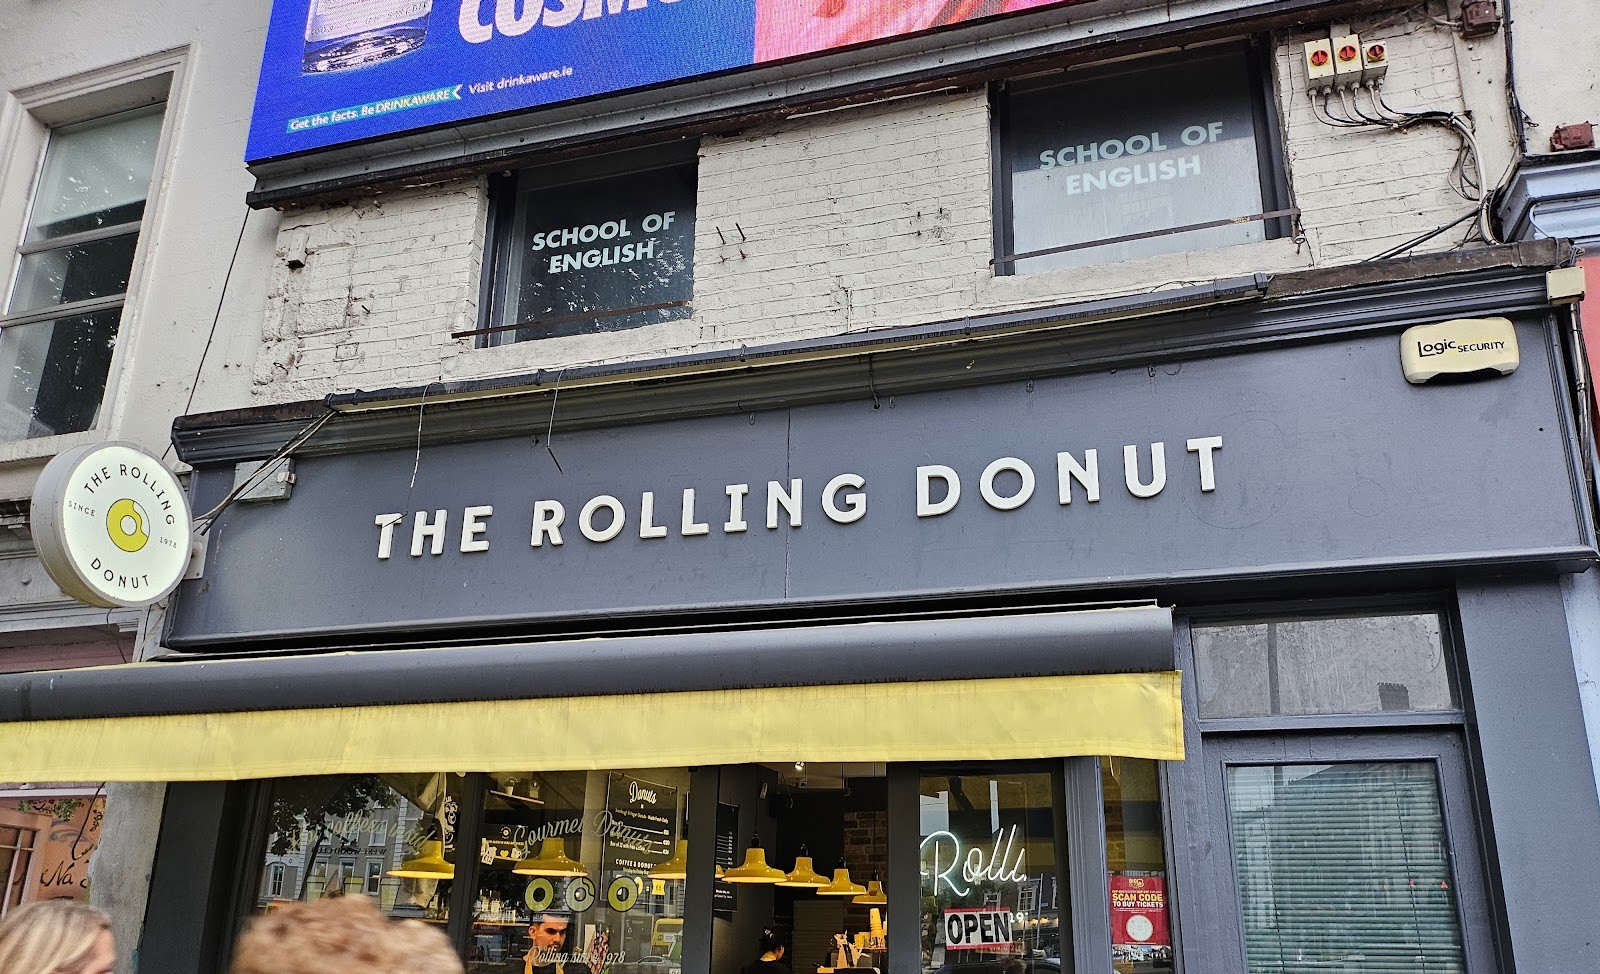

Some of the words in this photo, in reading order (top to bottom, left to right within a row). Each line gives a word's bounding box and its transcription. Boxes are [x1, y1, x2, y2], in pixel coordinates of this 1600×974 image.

[468, 82, 494, 95] Visit
[497, 66, 573, 89] drinkaware.ie
[290, 117, 309, 131] Get
[312, 113, 330, 126] the
[331, 109, 358, 123] facts.
[361, 104, 375, 116] Be
[375, 90, 450, 115] DRINKAWARE
[1039, 132, 1167, 170] SCHOOL
[1180, 121, 1223, 146] OF
[1066, 155, 1201, 196] ENGLISH
[532, 219, 631, 251] SCHOOL
[642, 211, 676, 233] OF
[549, 240, 654, 274] ENGLISH
[1417, 338, 1457, 358] Logic
[1457, 341, 1505, 353] SECURITY
[68, 500, 96, 517] SINCE
[84, 466, 111, 494] THE
[119, 463, 175, 525] ROLLING
[375, 504, 494, 559] THE
[530, 473, 867, 548] ROLLING
[916, 435, 1223, 518] DONUT
[159, 537, 177, 549] 1978
[90, 557, 149, 589] DONUT
[629, 781, 657, 804] Donuts
[1112, 893, 1136, 902] SCAN
[1138, 893, 1163, 902] CODE
[947, 912, 1010, 945] OPEN
[529, 946, 570, 968] Rolling
[602, 950, 626, 966] 1978
